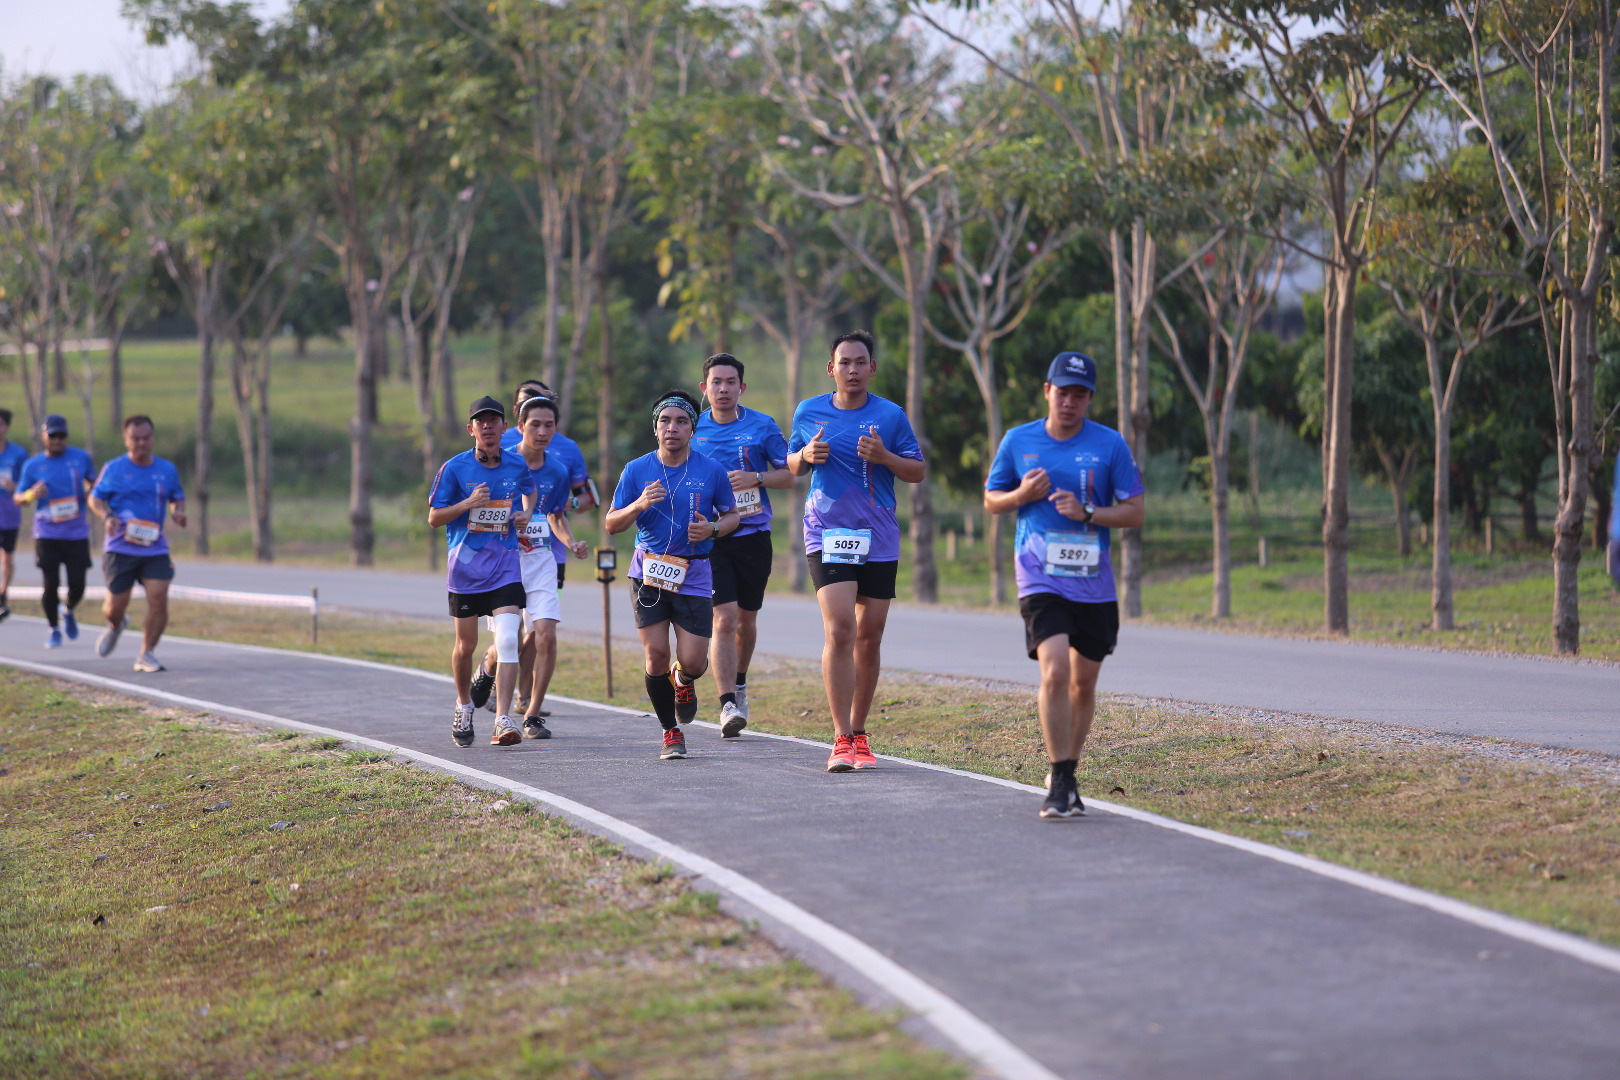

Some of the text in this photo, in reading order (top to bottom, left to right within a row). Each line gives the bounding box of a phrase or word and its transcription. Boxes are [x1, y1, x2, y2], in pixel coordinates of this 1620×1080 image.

[736, 490, 756, 504] 406
[478, 510, 507, 521] 8388
[526, 525, 543, 534] 064
[834, 540, 861, 550] 5057
[1059, 548, 1089, 561] 5297
[648, 562, 681, 580] 8009
